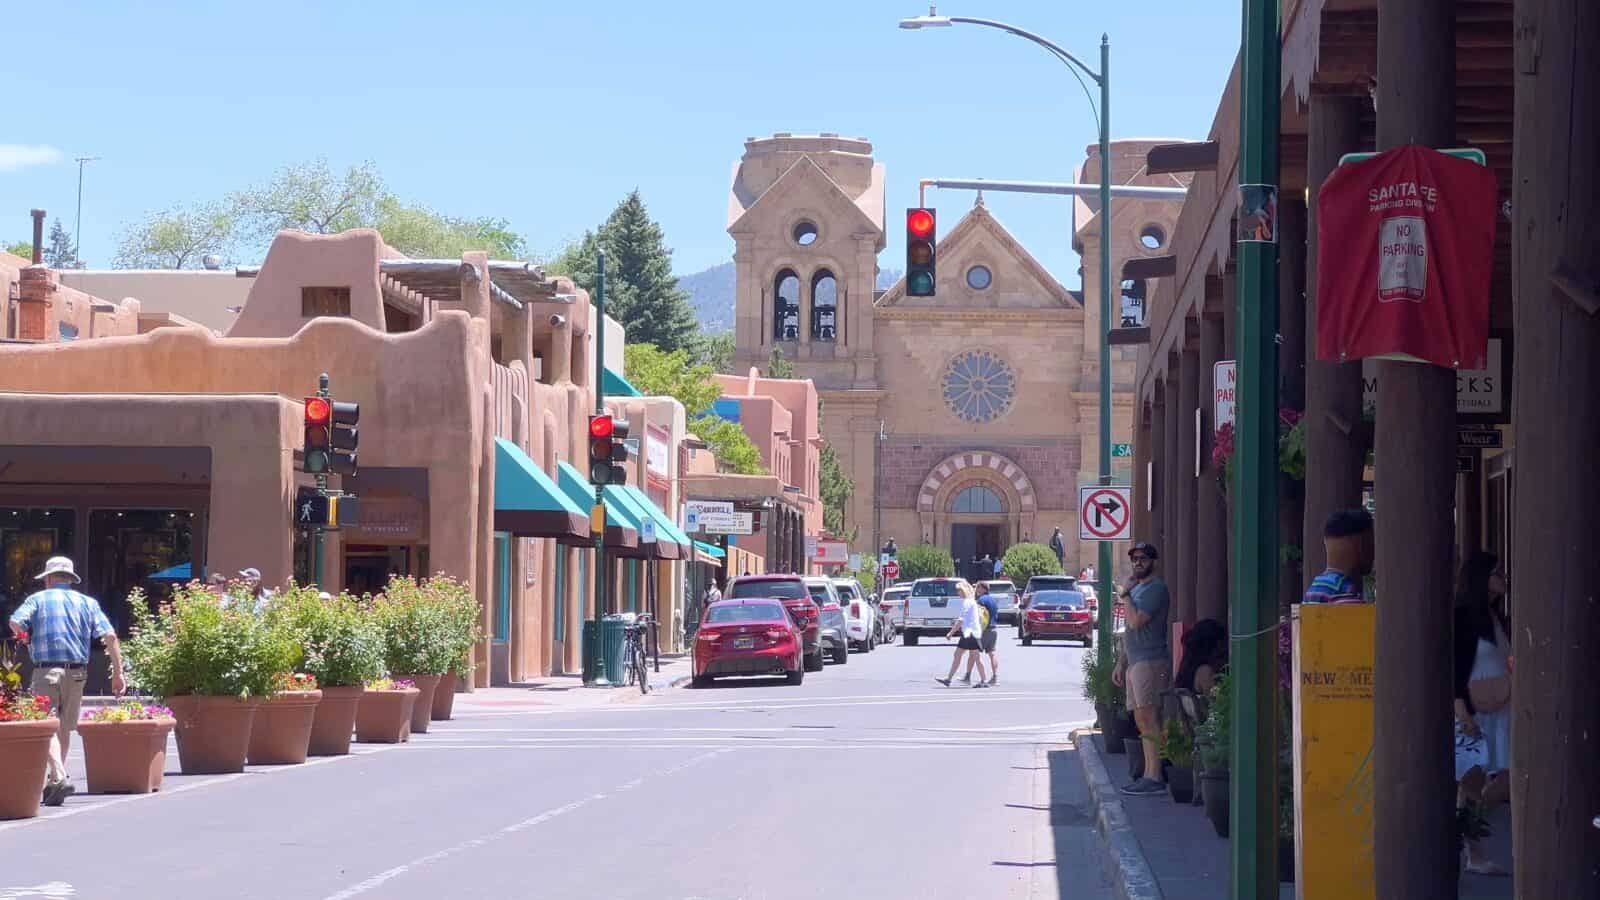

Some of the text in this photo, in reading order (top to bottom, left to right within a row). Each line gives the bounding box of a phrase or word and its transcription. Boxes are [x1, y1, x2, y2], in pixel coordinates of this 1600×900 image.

[1368, 183, 1417, 202] SANTA
[1369, 200, 1403, 213] PARKING
[1396, 224, 1411, 237] NO
[1383, 243, 1425, 257] PARKING
[1227, 368, 1235, 383] N
[1118, 444, 1132, 457] SA
[1302, 671, 1375, 685] NEW ME
